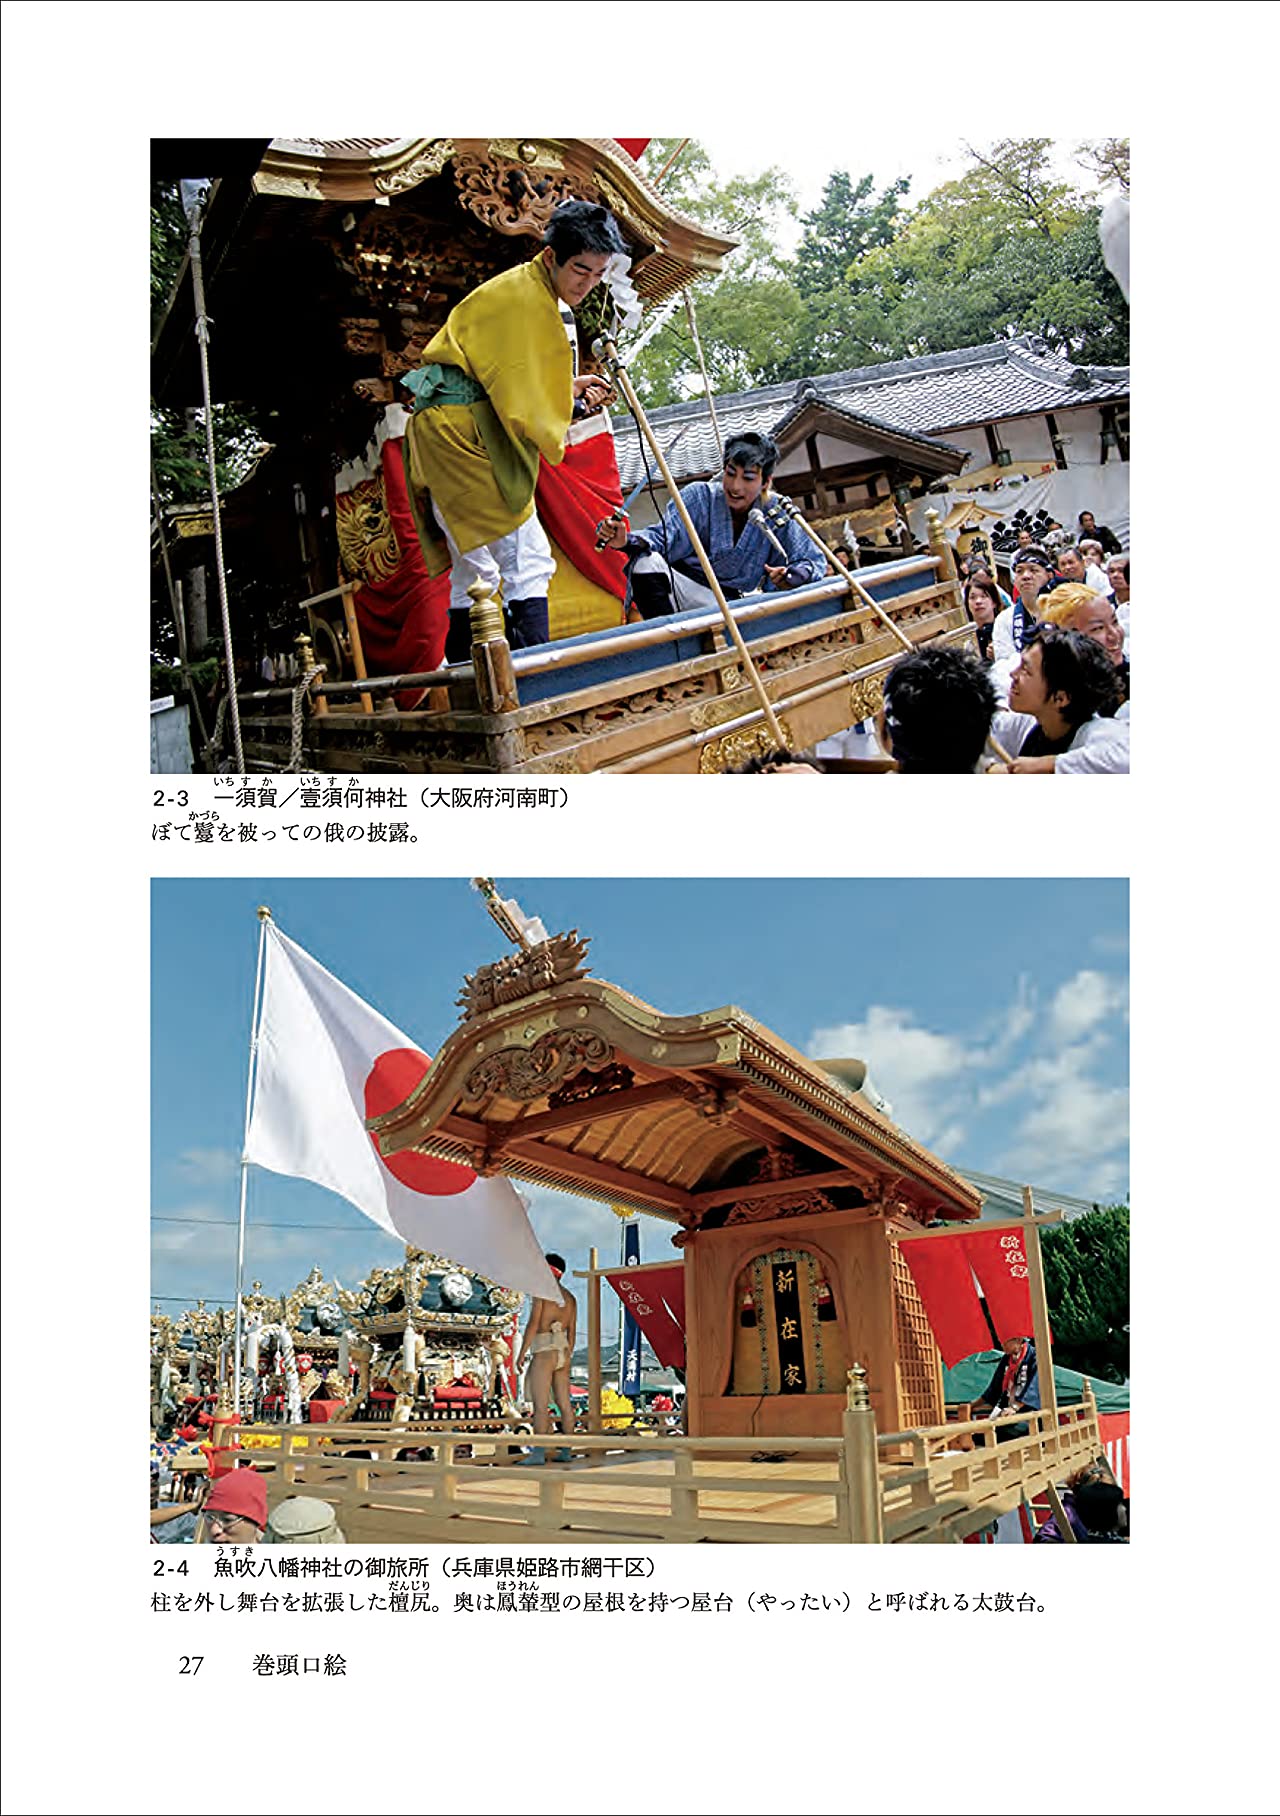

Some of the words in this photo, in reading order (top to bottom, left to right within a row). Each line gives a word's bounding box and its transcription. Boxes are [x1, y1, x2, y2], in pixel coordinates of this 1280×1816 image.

[153, 789, 189, 807] 2-3
[188, 811, 220, 821] かづら
[776, 1269, 802, 1386] 新在家
[216, 1546, 254, 1556] うすき
[153, 1559, 190, 1577] 2-4
[388, 1581, 430, 1591] だんじり
[496, 1581, 540, 1591] ほうれん
[178, 1655, 205, 1676] 27
[252, 1653, 347, 1677] 巻頭口絵
